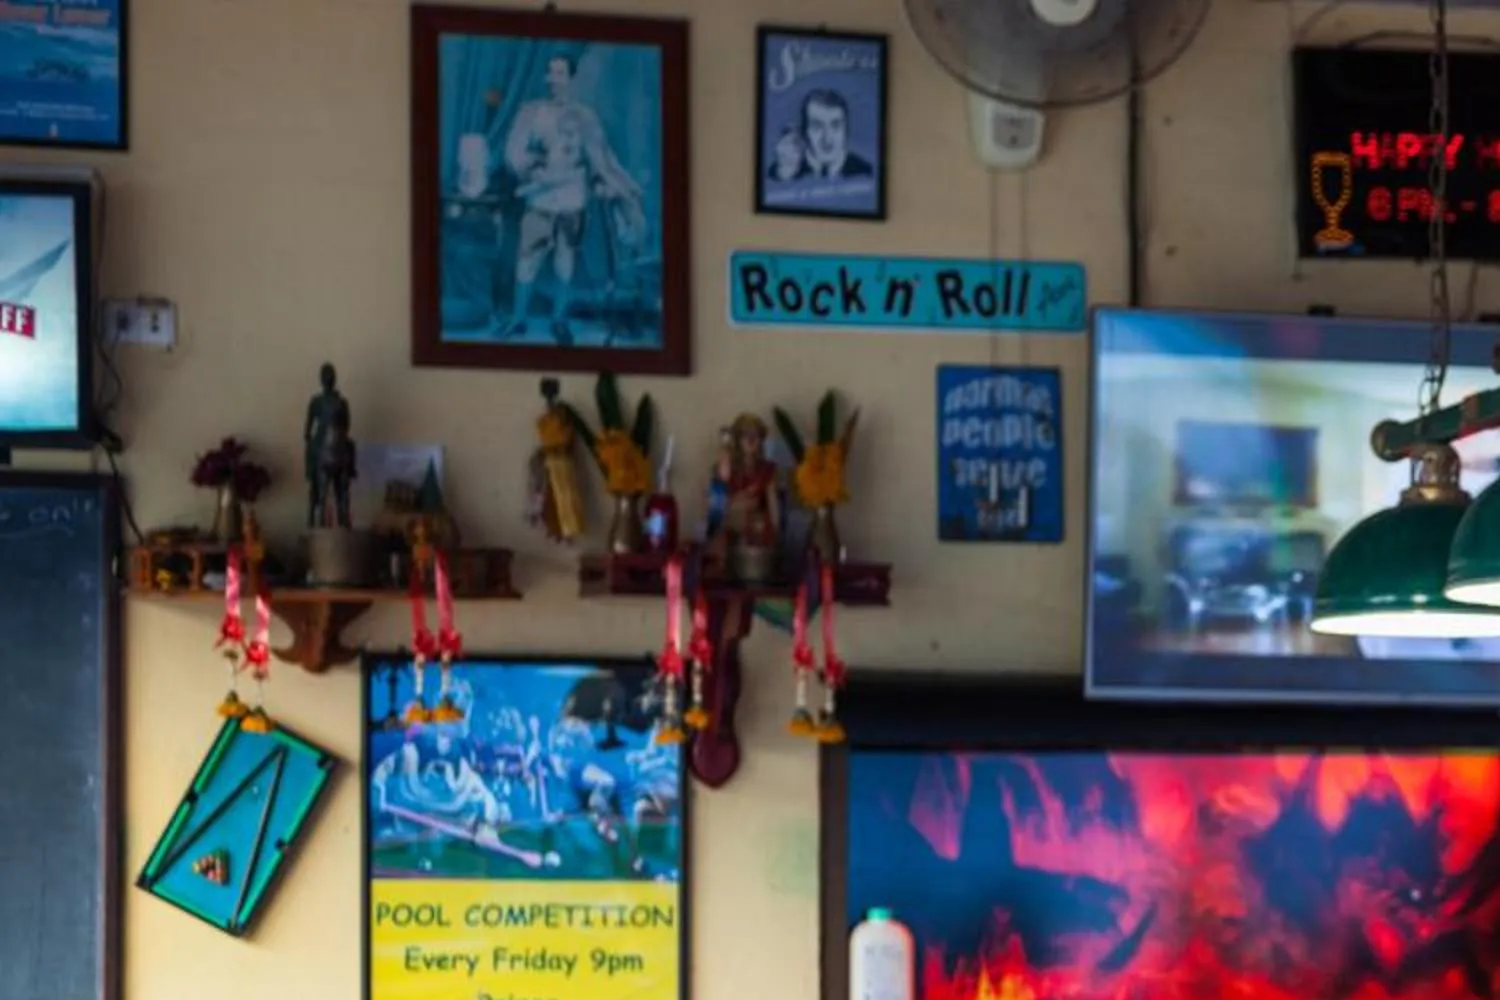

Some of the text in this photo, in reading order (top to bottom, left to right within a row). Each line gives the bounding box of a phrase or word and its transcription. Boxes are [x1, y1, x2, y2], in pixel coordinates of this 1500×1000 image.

[740, 263, 867, 315] Rock
[937, 270, 1029, 319] Roll
[375, 902, 675, 930] POOL COMPETITION
[404, 946, 644, 976] Every Friday 9pm
